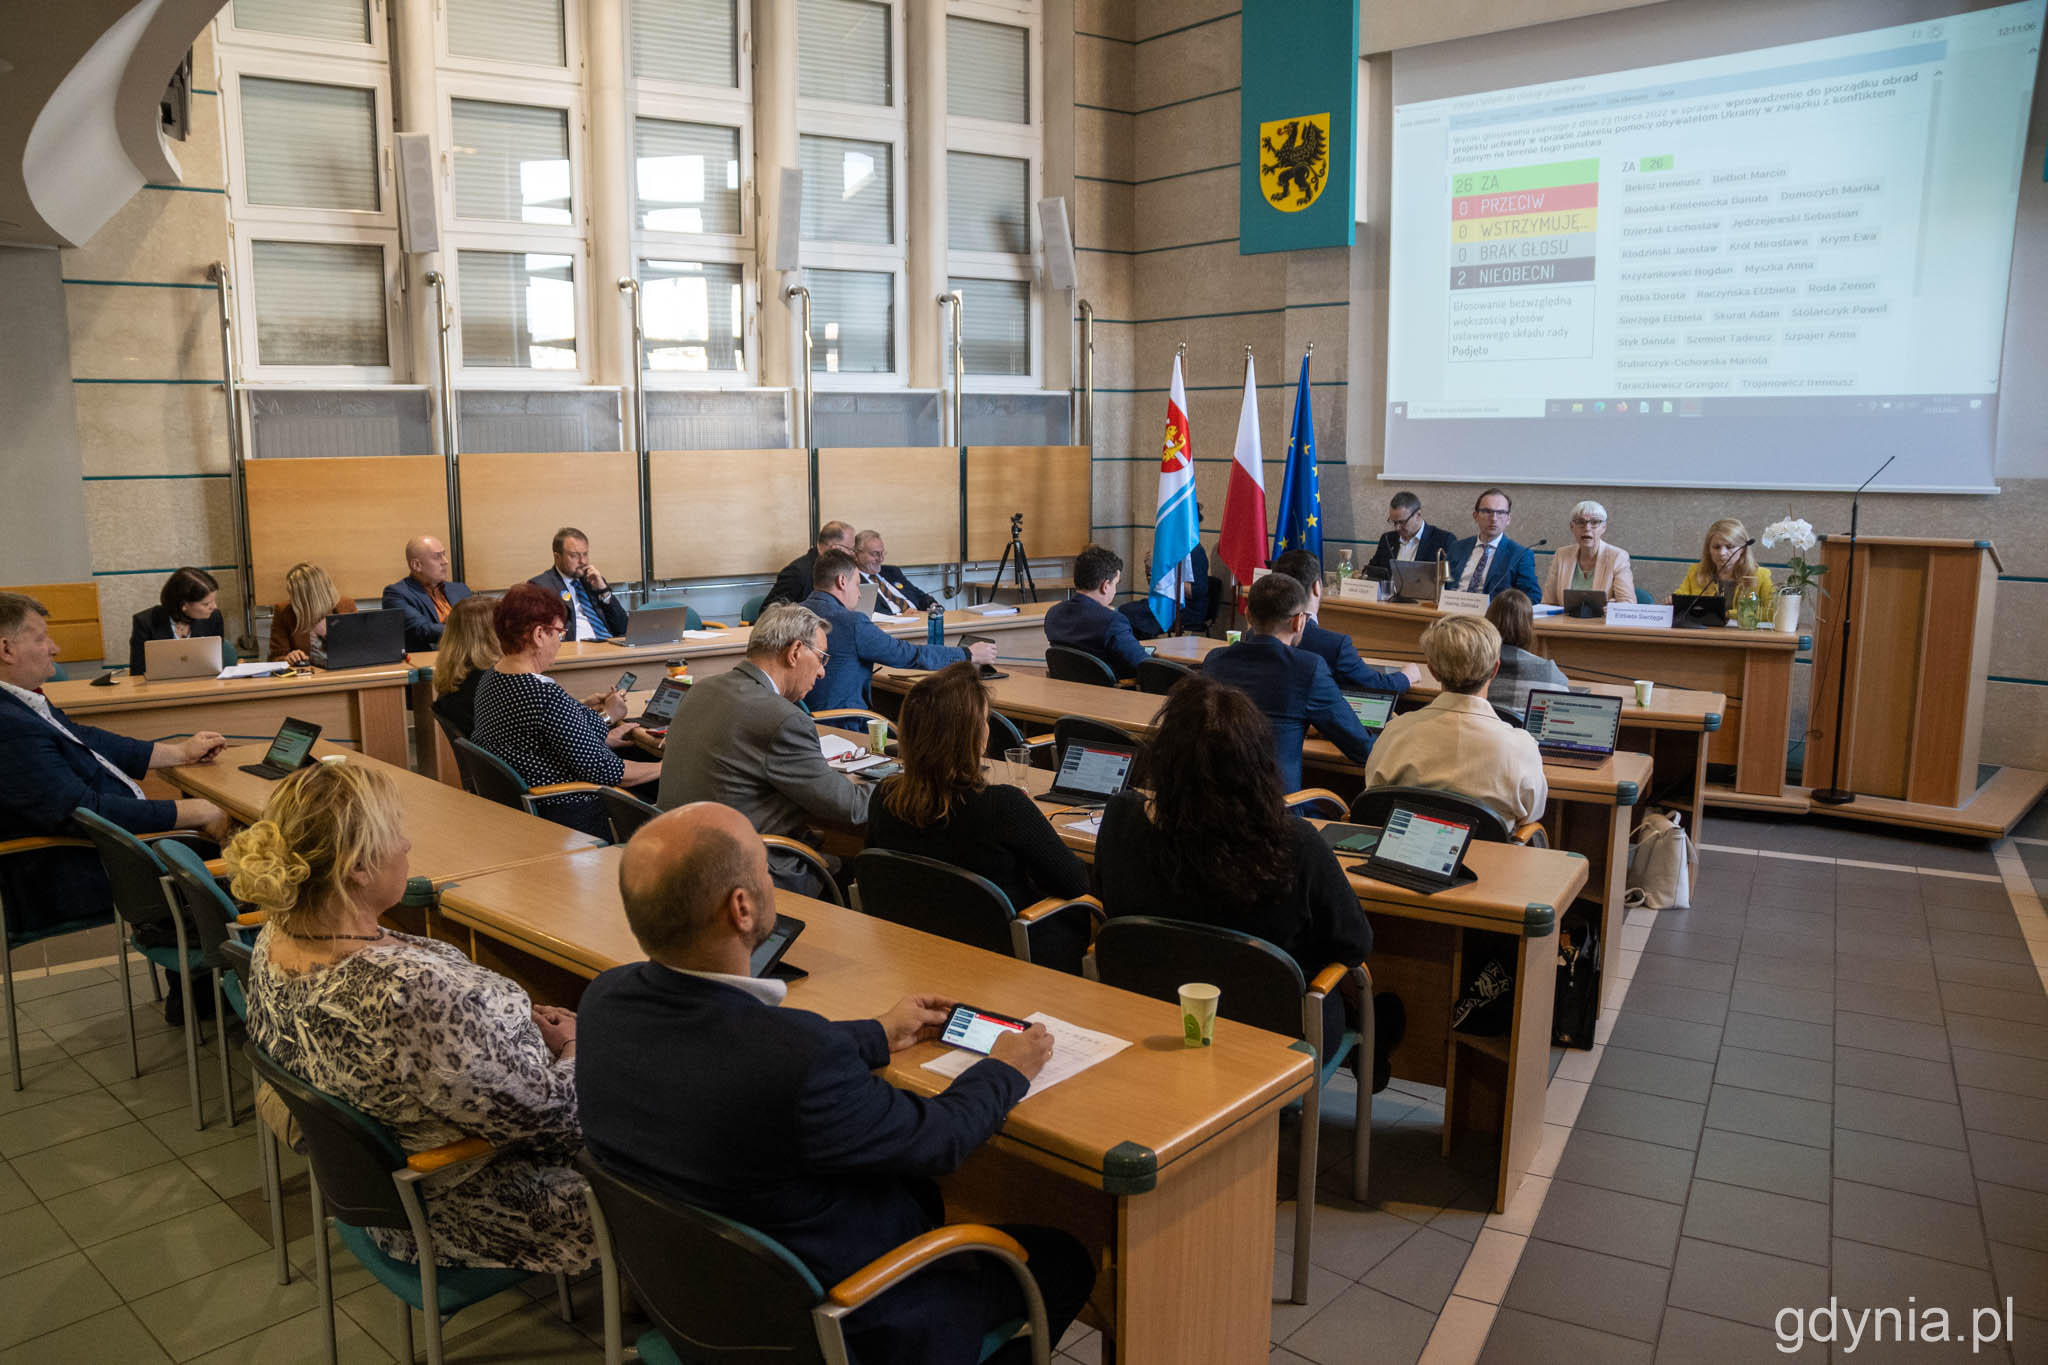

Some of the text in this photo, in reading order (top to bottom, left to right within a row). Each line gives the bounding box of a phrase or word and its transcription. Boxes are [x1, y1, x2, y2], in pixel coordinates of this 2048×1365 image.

[1725, 90, 1802, 108] wprowadzenie
[1806, 87, 1822, 97] do
[1882, 71, 1918, 87] obrad
[1614, 120, 1653, 134] pomocy
[1720, 106, 1760, 120] Ukrainy
[1832, 88, 1897, 105] konfliktem
[1621, 159, 1636, 173] ZA
[1750, 167, 1787, 180] Marcin
[1455, 175, 1500, 193] 26 ZA
[1458, 193, 1545, 216] 0 PRZECIW
[1458, 223, 1468, 240] 0
[1820, 231, 1878, 246] Krym Ewa
[1458, 239, 1569, 263] 0 BRAK GŁOSU
[1787, 259, 1815, 271] Anna
[1457, 264, 1554, 286] 2 NIEOBECNI
[1749, 308, 1780, 319] Adam
[1547, 325, 1569, 340] rady
